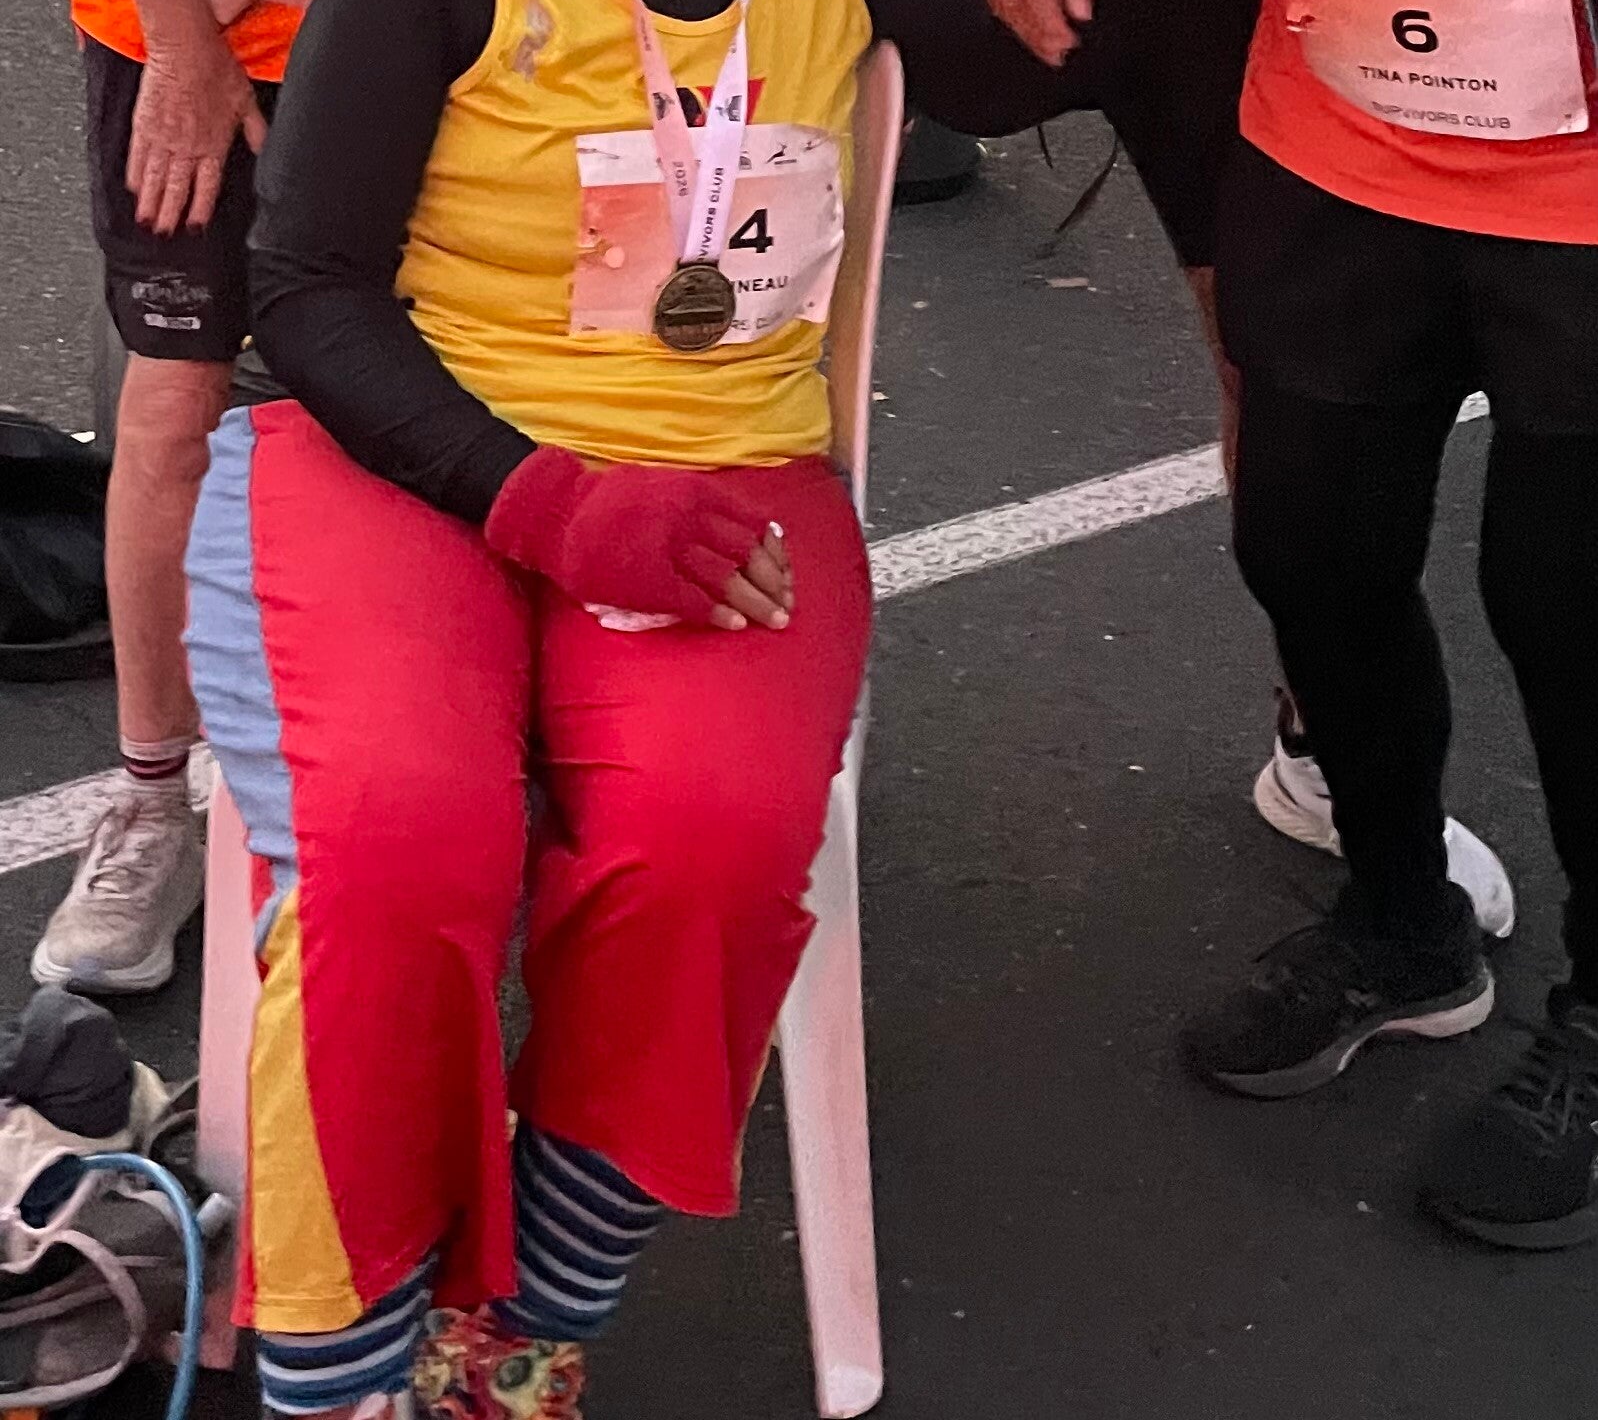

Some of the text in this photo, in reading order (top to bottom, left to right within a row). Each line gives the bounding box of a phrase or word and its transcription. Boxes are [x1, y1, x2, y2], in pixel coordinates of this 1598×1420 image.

[1391, 9, 1440, 54] 6
[1358, 65, 1498, 92] TINA POINTON
[1464, 114, 1511, 129] CLUB
[728, 207, 775, 254] 4
